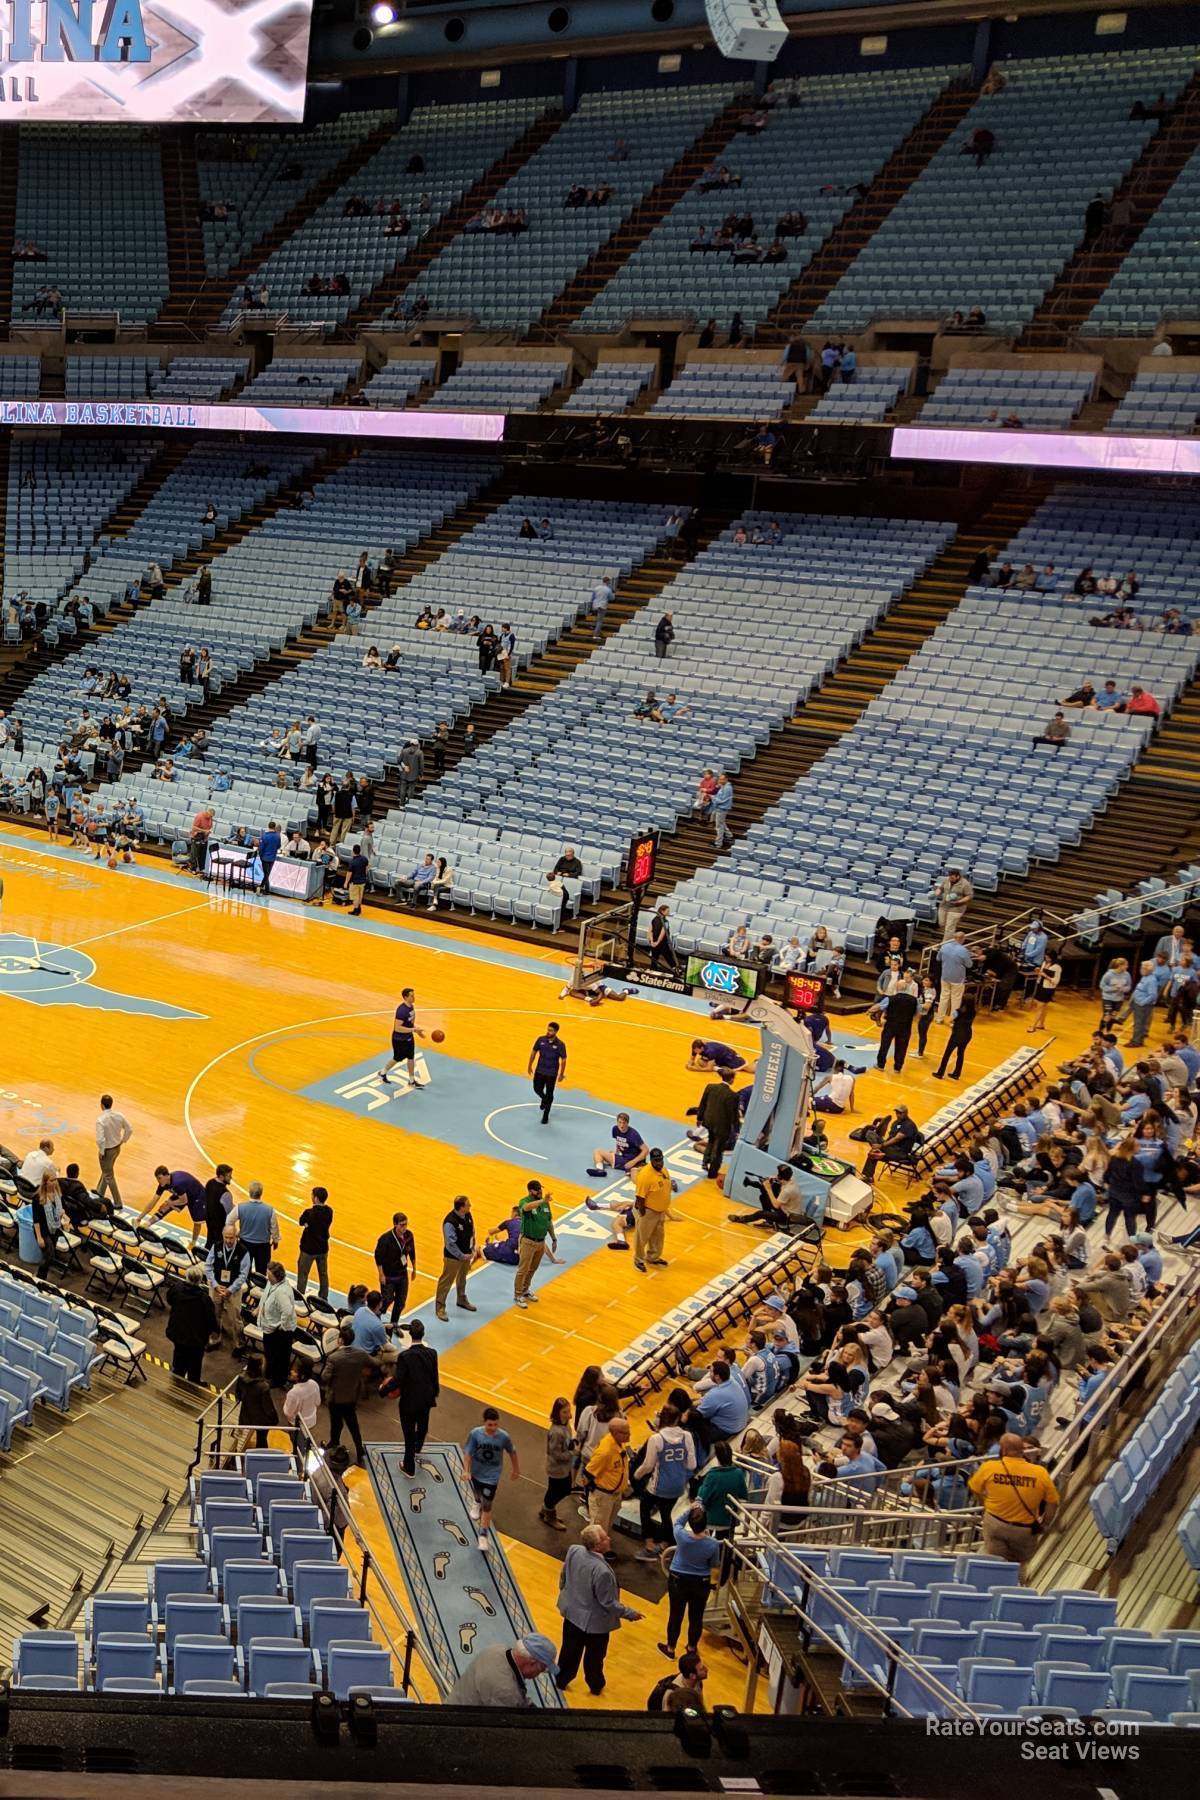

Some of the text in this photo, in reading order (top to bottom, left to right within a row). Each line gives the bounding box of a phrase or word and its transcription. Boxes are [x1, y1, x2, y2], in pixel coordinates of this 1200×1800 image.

[65, 403, 196, 426] BASKETBALL
[790, 976, 822, 992] 48:43
[794, 989, 813, 1005] 30
[762, 1042, 783, 1104] @GOHEELS
[664, 1448, 686, 1462] 23
[993, 1473, 1038, 1489] SECURITY
